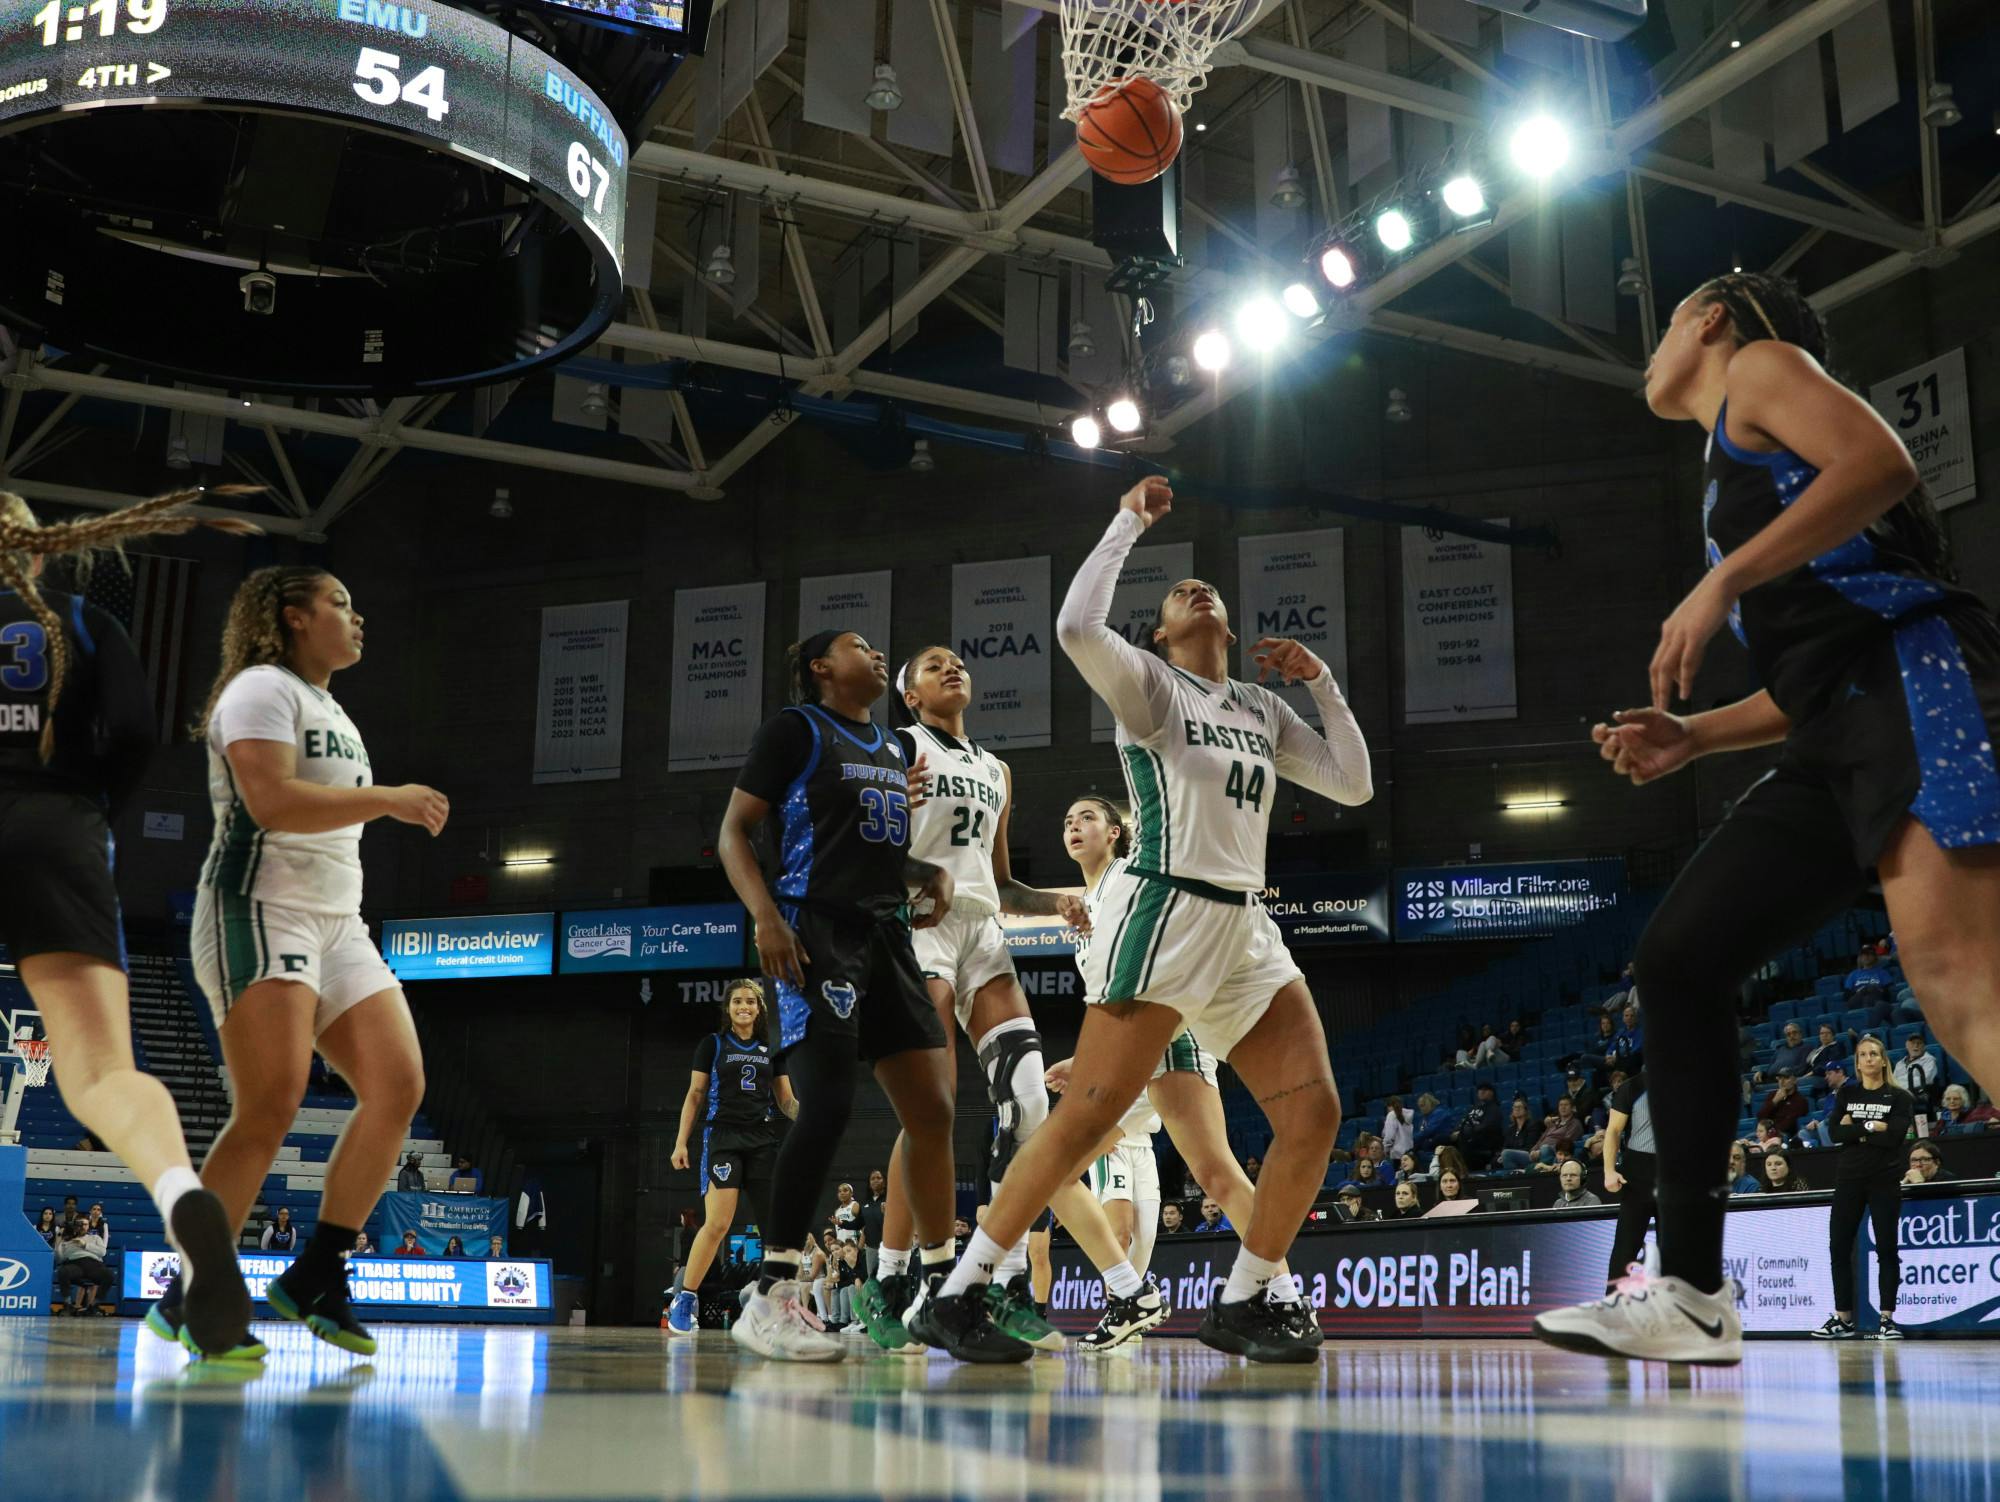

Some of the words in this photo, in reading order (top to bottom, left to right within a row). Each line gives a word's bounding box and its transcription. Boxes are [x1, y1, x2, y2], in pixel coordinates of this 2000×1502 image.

[33, 0, 167, 46] 1:19
[338, 0, 428, 38] EMU
[78, 63, 138, 89] 4TH
[353, 47, 449, 121] 54
[545, 70, 623, 168] BUFFALO
[568, 141, 609, 214] 67
[1897, 373, 1940, 429] 31
[1435, 544, 1477, 553] WOMEN'S
[1270, 552, 1311, 562] WOMEN'S
[1428, 552, 1484, 563] BASKETBALL
[1121, 566, 1163, 576] WOMEN'S
[1264, 561, 1317, 572] BASKETBALL
[827, 592, 864, 602] WOMEN'S
[981, 586, 1021, 596] WOMEN'S
[1420, 589, 1450, 599] EAST
[1453, 585, 1494, 597] COAST
[821, 601, 870, 611] BASKETBALL
[974, 595, 1027, 605] BASKETBALL
[1277, 595, 1306, 605] 2022
[1417, 597, 1499, 613] CONFERENCE
[701, 605, 738, 614] WOMEN'S
[1130, 608, 1156, 619] 2019
[695, 613, 742, 623] BASKETBALL
[1258, 606, 1326, 633] MAC
[1422, 612, 1495, 626] CHAMPIONS
[989, 622, 1014, 633] 2018
[692, 639, 742, 660] MAC
[960, 633, 1040, 659] NCAA
[1438, 639, 1480, 650] 1991-92
[688, 663, 709, 671] EAST
[711, 659, 747, 669] DIVISION
[688, 669, 747, 682] CHAMPIONS
[579, 684, 603, 694] WNIT
[983, 690, 1017, 699] SWEET
[580, 695, 608, 705] NCAA
[980, 701, 1021, 712] SIXTEEN
[580, 706, 607, 716] NCAA
[579, 717, 606, 727] NCAA
[551, 730, 574, 739] 2022
[579, 728, 606, 737] NCAA
[1184, 720, 1275, 761] EASTERN
[1225, 760, 1265, 813] 44
[922, 774, 1002, 813] EASTERN
[860, 787, 908, 847] 35
[1452, 876, 1512, 897] Millard
[1517, 875, 1590, 894] Fillmore
[1313, 899, 1368, 913] GROUP
[568, 924, 600, 938] Great
[600, 922, 631, 936] Lakes
[641, 924, 669, 938] Your
[672, 924, 701, 936] Care
[704, 922, 737, 934] Team
[1300, 924, 1350, 934] MassMutual
[1351, 923, 1368, 932] firm
[437, 930, 539, 952] Broadview
[573, 939, 603, 948] Cancer
[606, 938, 625, 947] Care
[1040, 932, 1058, 945] for
[640, 942, 659, 957] for
[661, 941, 689, 954] Life.
[436, 956, 468, 966] Federal
[470, 954, 496, 965] Credit
[497, 953, 524, 963] Union
[740, 1064, 757, 1090] 2
[1113, 1175, 1125, 1188] E
[448, 1206, 490, 1214] AMERICAN
[1757, 1256, 1809, 1272] Community
[356, 1262, 401, 1278] TRADE
[402, 1263, 456, 1280] UNIONS
[1898, 1263, 1979, 1285] ancer
[1311, 1272, 1327, 1308] a
[1334, 1254, 1439, 1309] SOBER
[1448, 1249, 1531, 1307] Plan!
[1757, 1275, 1797, 1289] Focused.
[409, 1282, 462, 1302] UNITY
[1757, 1295, 1787, 1310] Saving
[1789, 1293, 1816, 1307] Lives.
[1896, 1293, 1958, 1306] ollaborative
